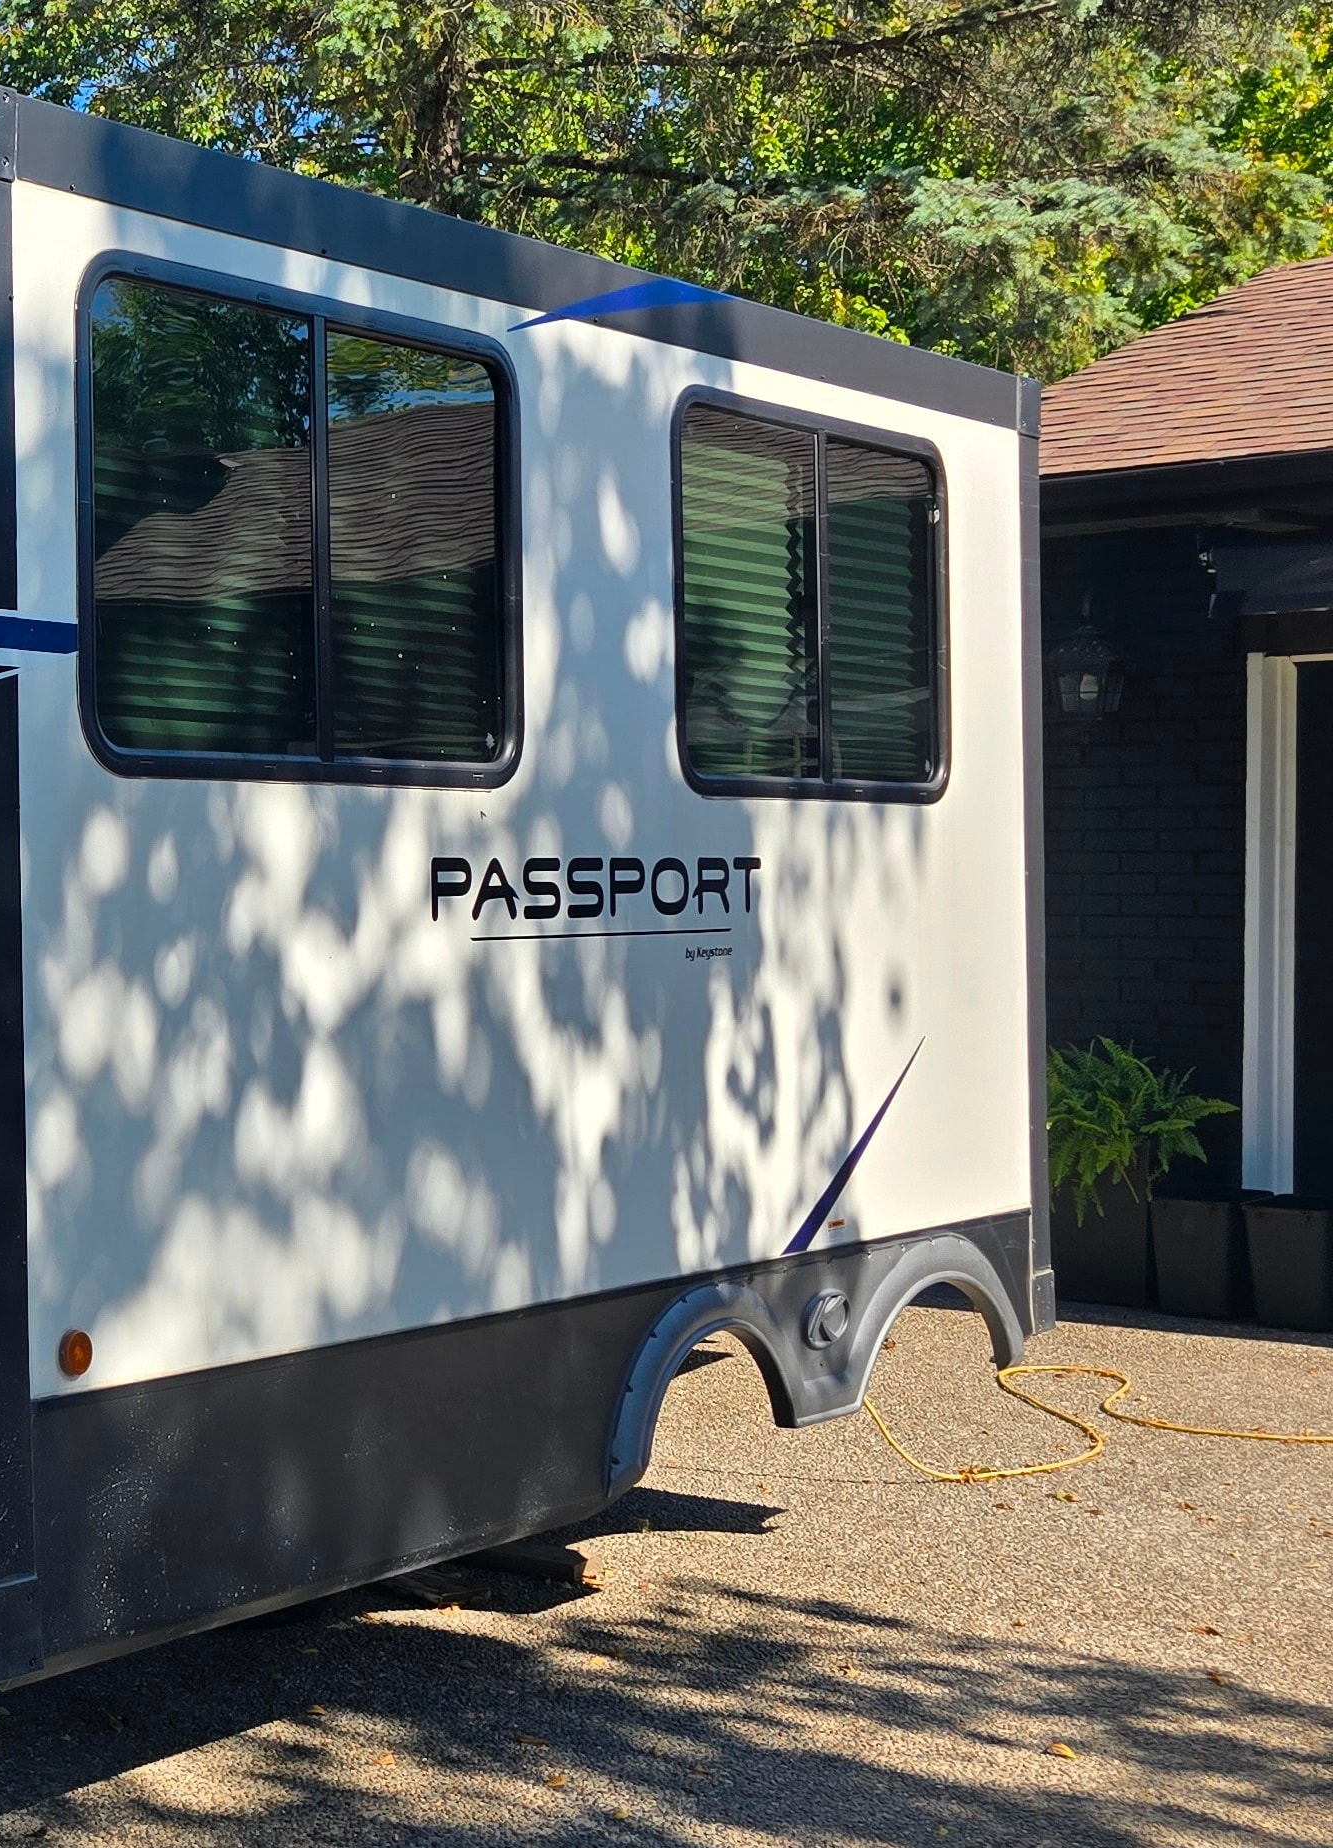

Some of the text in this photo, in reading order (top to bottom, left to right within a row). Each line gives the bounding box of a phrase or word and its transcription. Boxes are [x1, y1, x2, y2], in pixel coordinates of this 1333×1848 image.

[431, 857, 762, 921] PASSPORT
[685, 946, 732, 961] by Keystone
